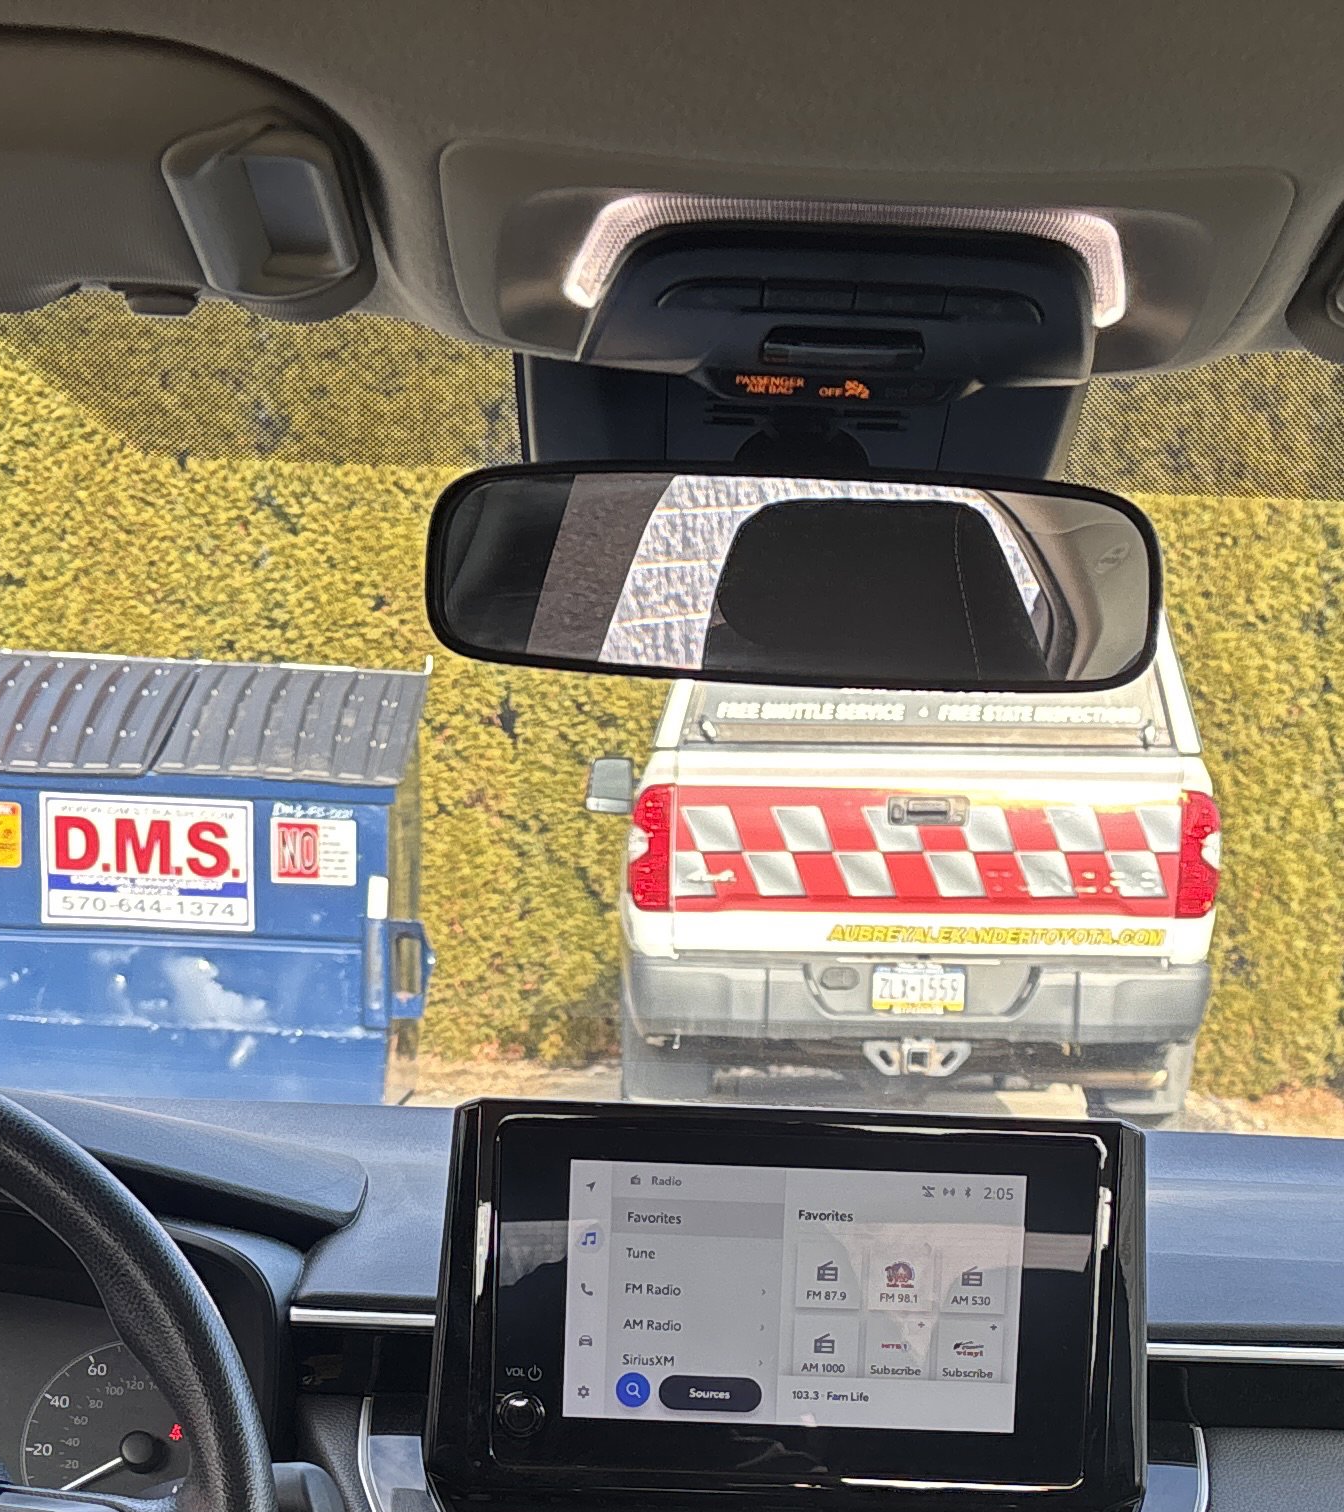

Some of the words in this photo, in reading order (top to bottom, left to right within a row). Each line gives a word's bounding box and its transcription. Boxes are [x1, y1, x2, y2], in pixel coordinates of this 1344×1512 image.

[735, 374, 805, 387] PASSENGER
[746, 386, 767, 394] AIR
[768, 386, 794, 395] BAG
[819, 387, 843, 397] OFF
[716, 702, 761, 719] FREE
[761, 702, 835, 720] SHUTTLE
[835, 703, 905, 721] SERVICE
[938, 704, 982, 722] FREE
[54, 815, 240, 878] D.M.S.
[278, 827, 318, 874] NO
[61, 895, 235, 918] 570-644-1374
[827, 924, 1167, 946] AUBREYALEXANDERTOYOTA.COM
[651, 1176, 682, 1187] Radio
[983, 1187, 1014, 1200] 2:05
[627, 1211, 682, 1225] Favorites
[798, 1209, 854, 1223] Favorites
[626, 1247, 656, 1260] Tune
[625, 1282, 643, 1295] FM
[647, 1283, 682, 1296] Radio
[806, 1290, 821, 1300] FM
[824, 1290, 847, 1301] 87.9
[879, 1292, 894, 1303] FM
[897, 1293, 918, 1304] 98.1
[951, 1295, 968, 1306] AM
[971, 1296, 991, 1306] 530
[623, 1319, 643, 1331] AM
[647, 1319, 682, 1332] Radio
[622, 1353, 675, 1367] SiriusXM
[88, 1364, 107, 1376] 60
[506, 1367, 526, 1377] VOL
[801, 1362, 819, 1373] AM
[821, 1363, 846, 1374] 1000
[870, 1365, 922, 1377] Subscribe
[942, 1367, 993, 1380] Subscribe
[105, 1386, 124, 1396] 100
[126, 1380, 144, 1390] 120
[688, 1387, 731, 1400] Sources
[792, 1390, 819, 1401] 103.3
[850, 1391, 869, 1402] Life
[50, 1396, 70, 1408] 40
[89, 1400, 104, 1409] 80
[74, 1416, 89, 1425] 60
[65, 1438, 80, 1447] 40
[33, 1444, 53, 1455] 20
[65, 1460, 79, 1469] 20
